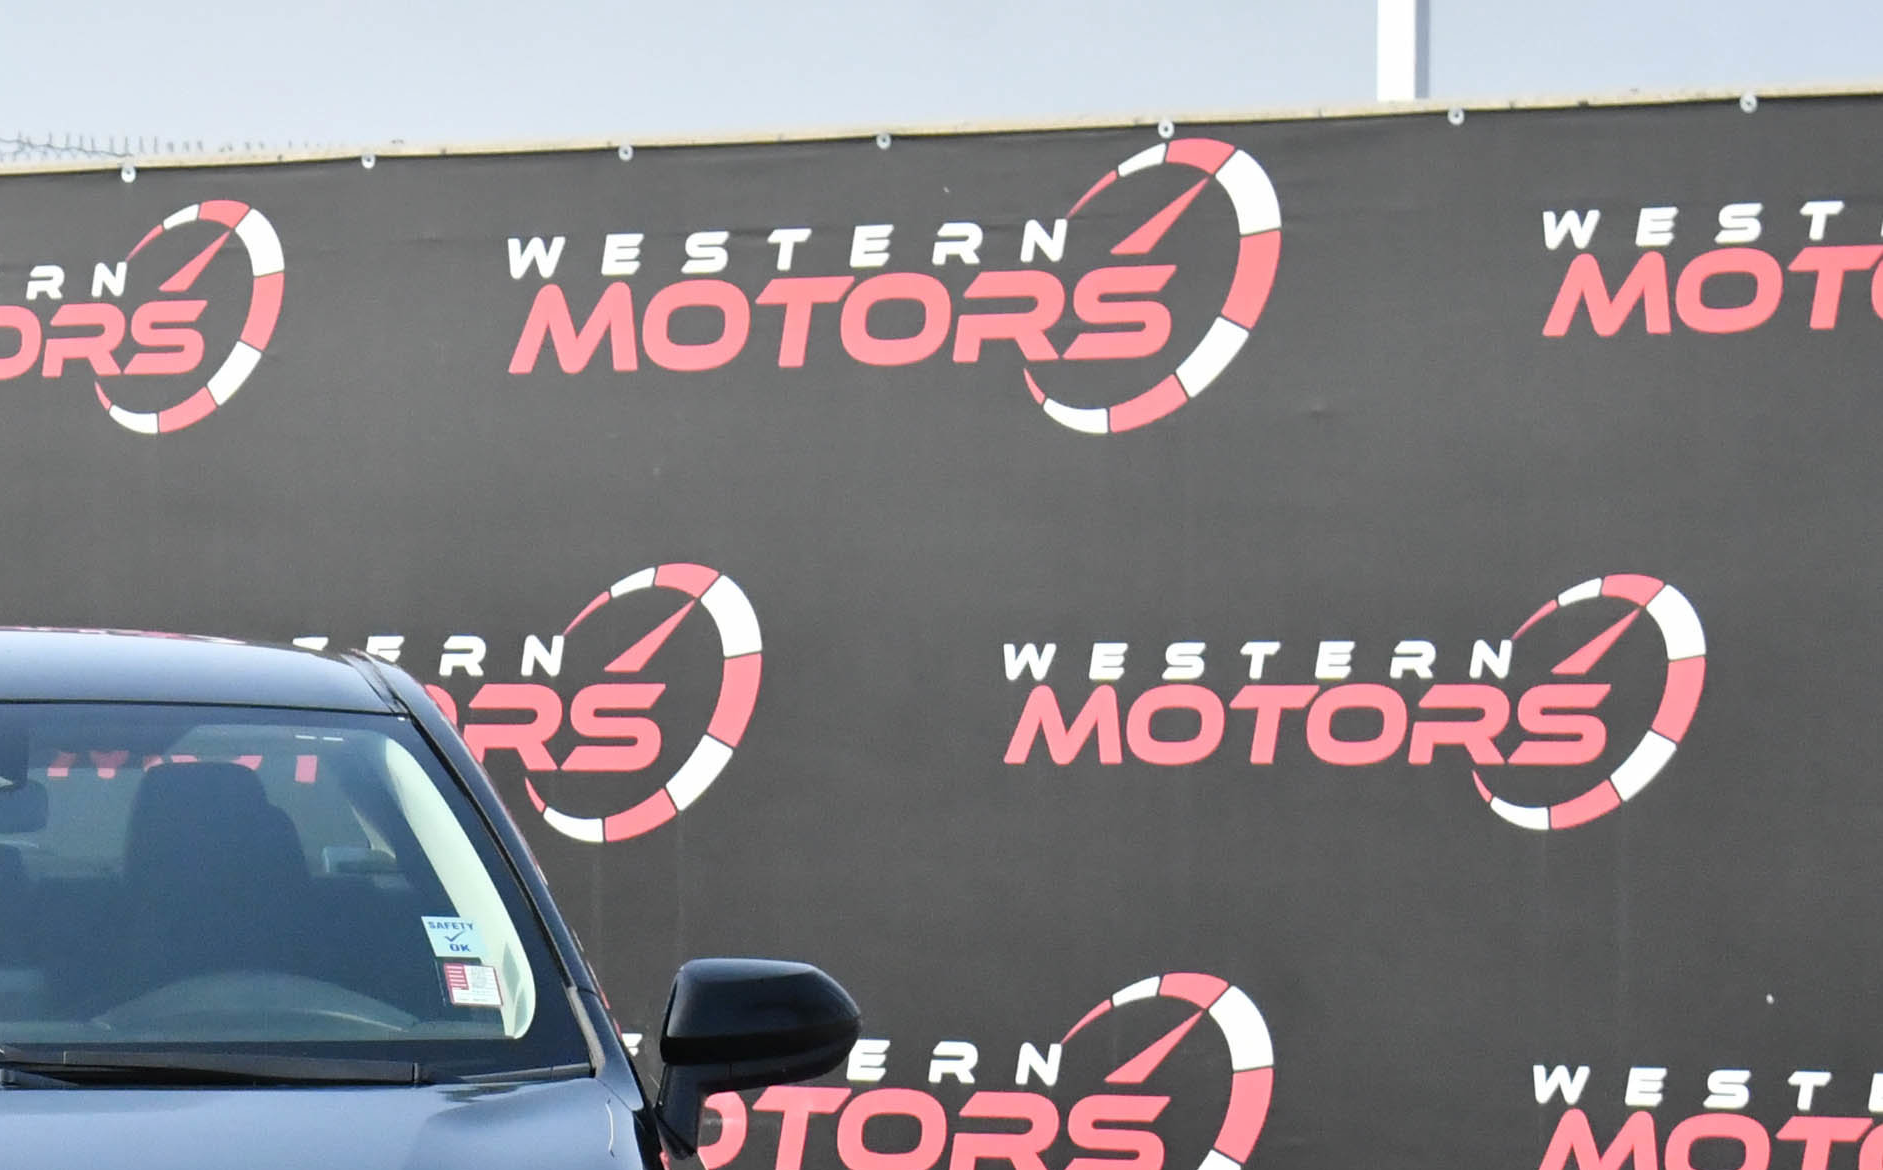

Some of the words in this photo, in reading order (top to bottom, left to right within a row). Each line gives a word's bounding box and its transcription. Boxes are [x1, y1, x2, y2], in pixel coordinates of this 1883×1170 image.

[506, 217, 1069, 281] WESTERN
[1542, 200, 1883, 251] WEST
[1542, 243, 1883, 338] MOT
[507, 263, 1177, 375] MOTORS
[1002, 639, 1514, 683] WESTERN
[1004, 682, 1612, 767] MOTORS
[427, 921, 474, 930] SAFETY
[449, 943, 471, 952] OK
[1532, 1064, 1883, 1112] WEST
